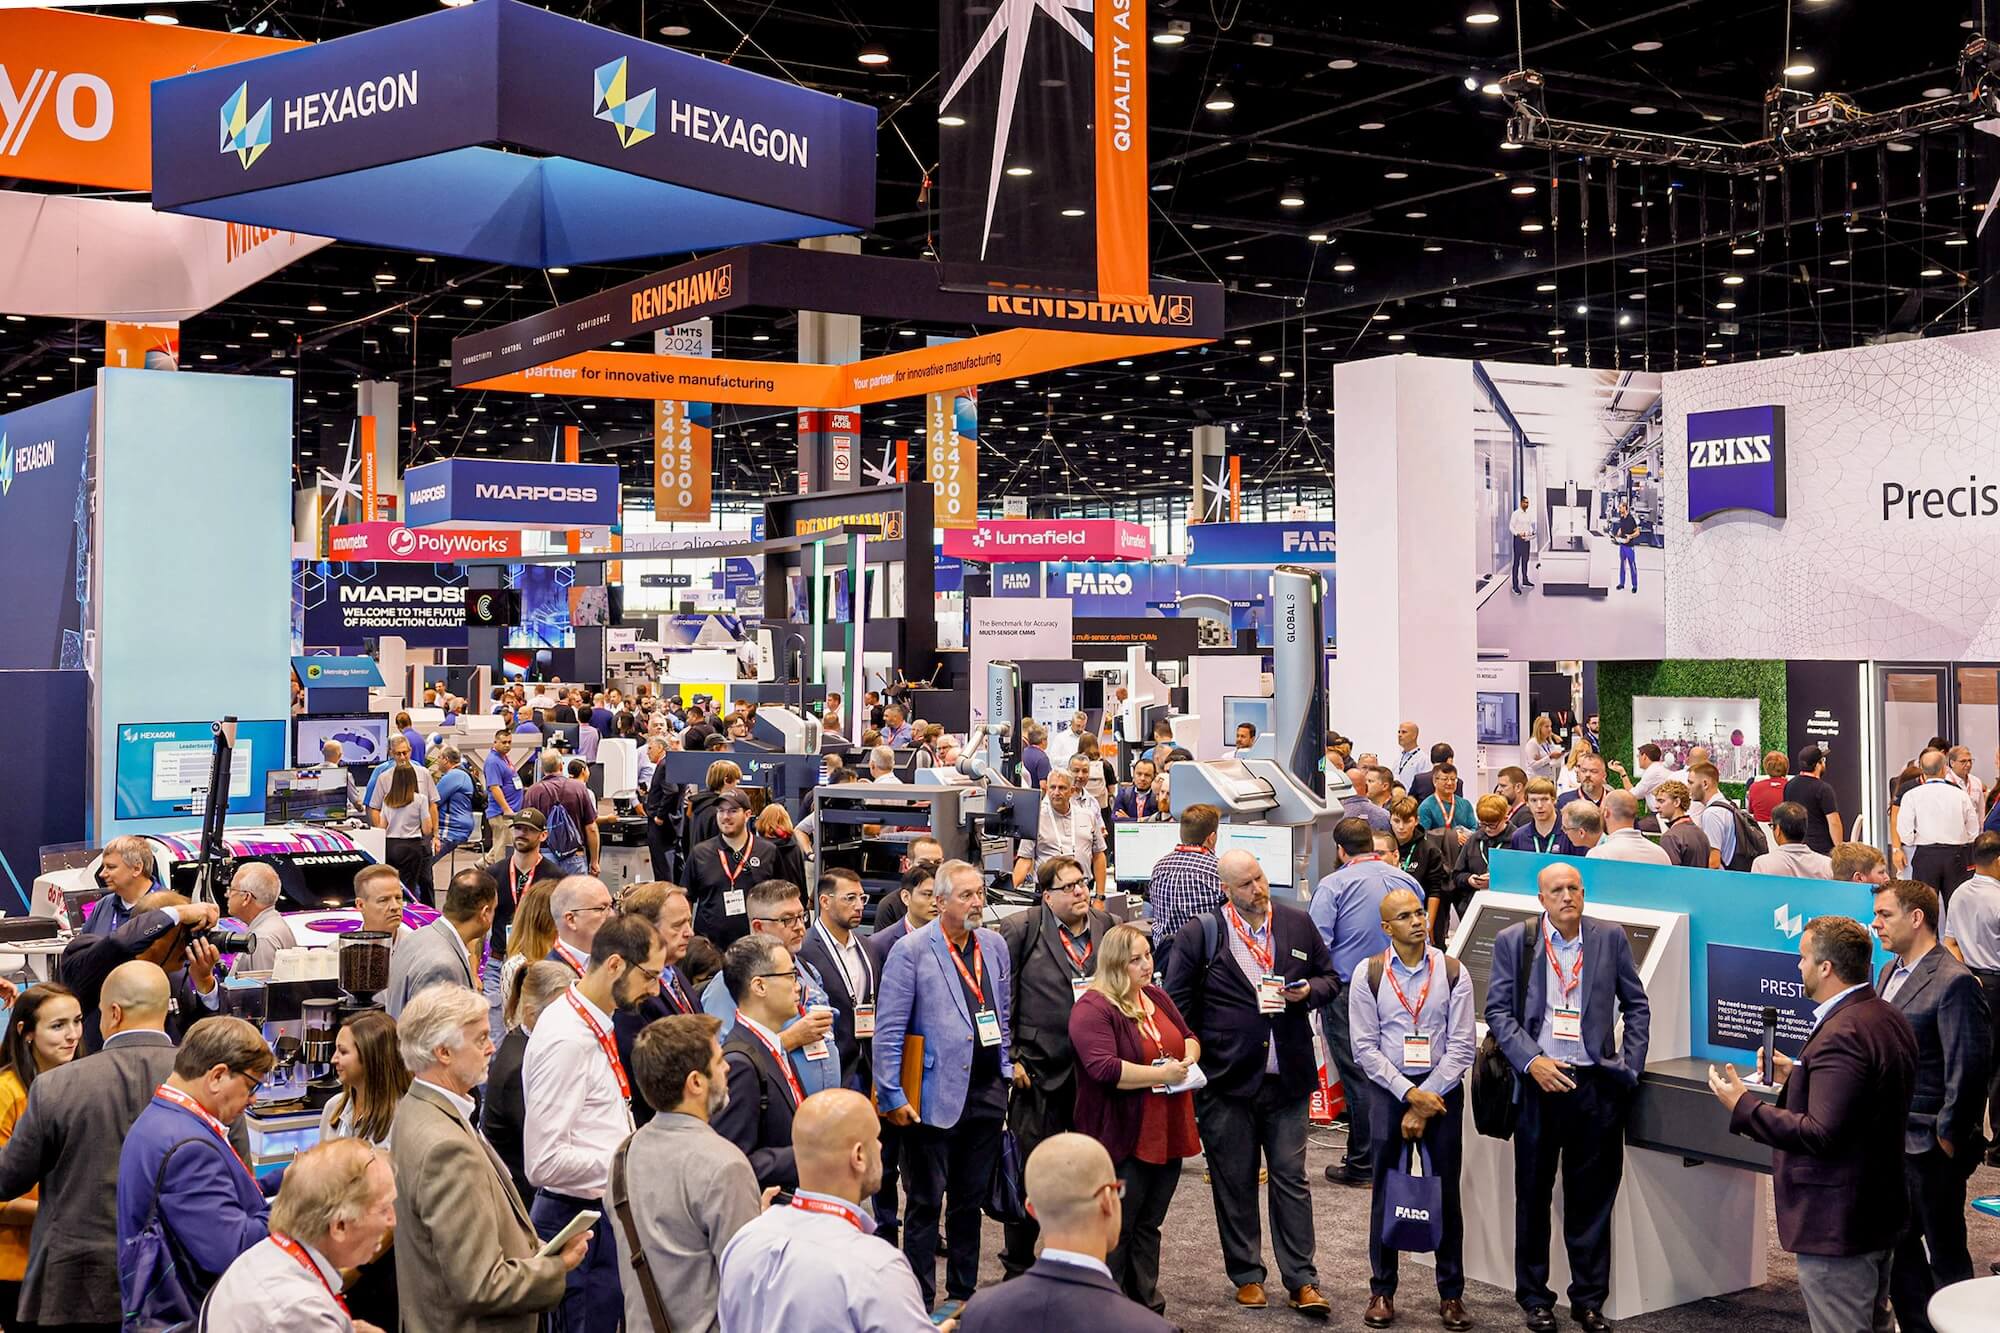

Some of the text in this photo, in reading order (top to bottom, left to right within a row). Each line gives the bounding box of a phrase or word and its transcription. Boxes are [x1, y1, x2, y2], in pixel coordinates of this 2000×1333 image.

[284, 70, 418, 134] HEXAGON
[1113, 36, 1131, 152] QUALITY
[671, 99, 808, 168] HEXAGON
[631, 268, 717, 323] RENISHAW
[577, 313, 610, 332] CONFIDENCE
[532, 329, 566, 346] CONSISTENCY
[677, 327, 703, 338] IMTS
[501, 343, 522, 355] CONTROL
[664, 337, 702, 352] 2024
[524, 365, 578, 380] partner
[581, 366, 601, 380] for
[604, 368, 675, 385] innovative
[678, 374, 774, 392] manufacturing
[853, 352, 1001, 391] Your partner for innovative manufacturing
[832, 421, 851, 429] HOSE
[833, 415, 849, 423] FIRE
[16, 440, 55, 473] HEXAGON
[1690, 435, 1771, 468] ZEISS
[948, 414, 960, 514] 134700
[410, 485, 446, 505] MARPOSS
[476, 484, 598, 503] MARPOSS
[1883, 475, 1999, 520] Precis
[419, 535, 508, 555] PolyWorks
[624, 538, 678, 552] Bruker
[996, 530, 1086, 545] lumafield
[1002, 573, 1030, 589] FARO
[1066, 572, 1131, 594] FARO
[343, 608, 466, 617] WELCOME TO THE FUTUR
[1287, 593, 1295, 643] GLOBAL S
[344, 618, 466, 627] OF PRODUCTION QUALIT
[1033, 620, 1058, 629] Accuracy
[1111, 634, 1130, 642] system
[140, 731, 176, 739] HEXAGON
[292, 854, 364, 866] BOWMAN
[1761, 978, 1805, 998] PREST
[1312, 1091, 1324, 1113] 100
[1395, 1206, 1430, 1221] FARO
